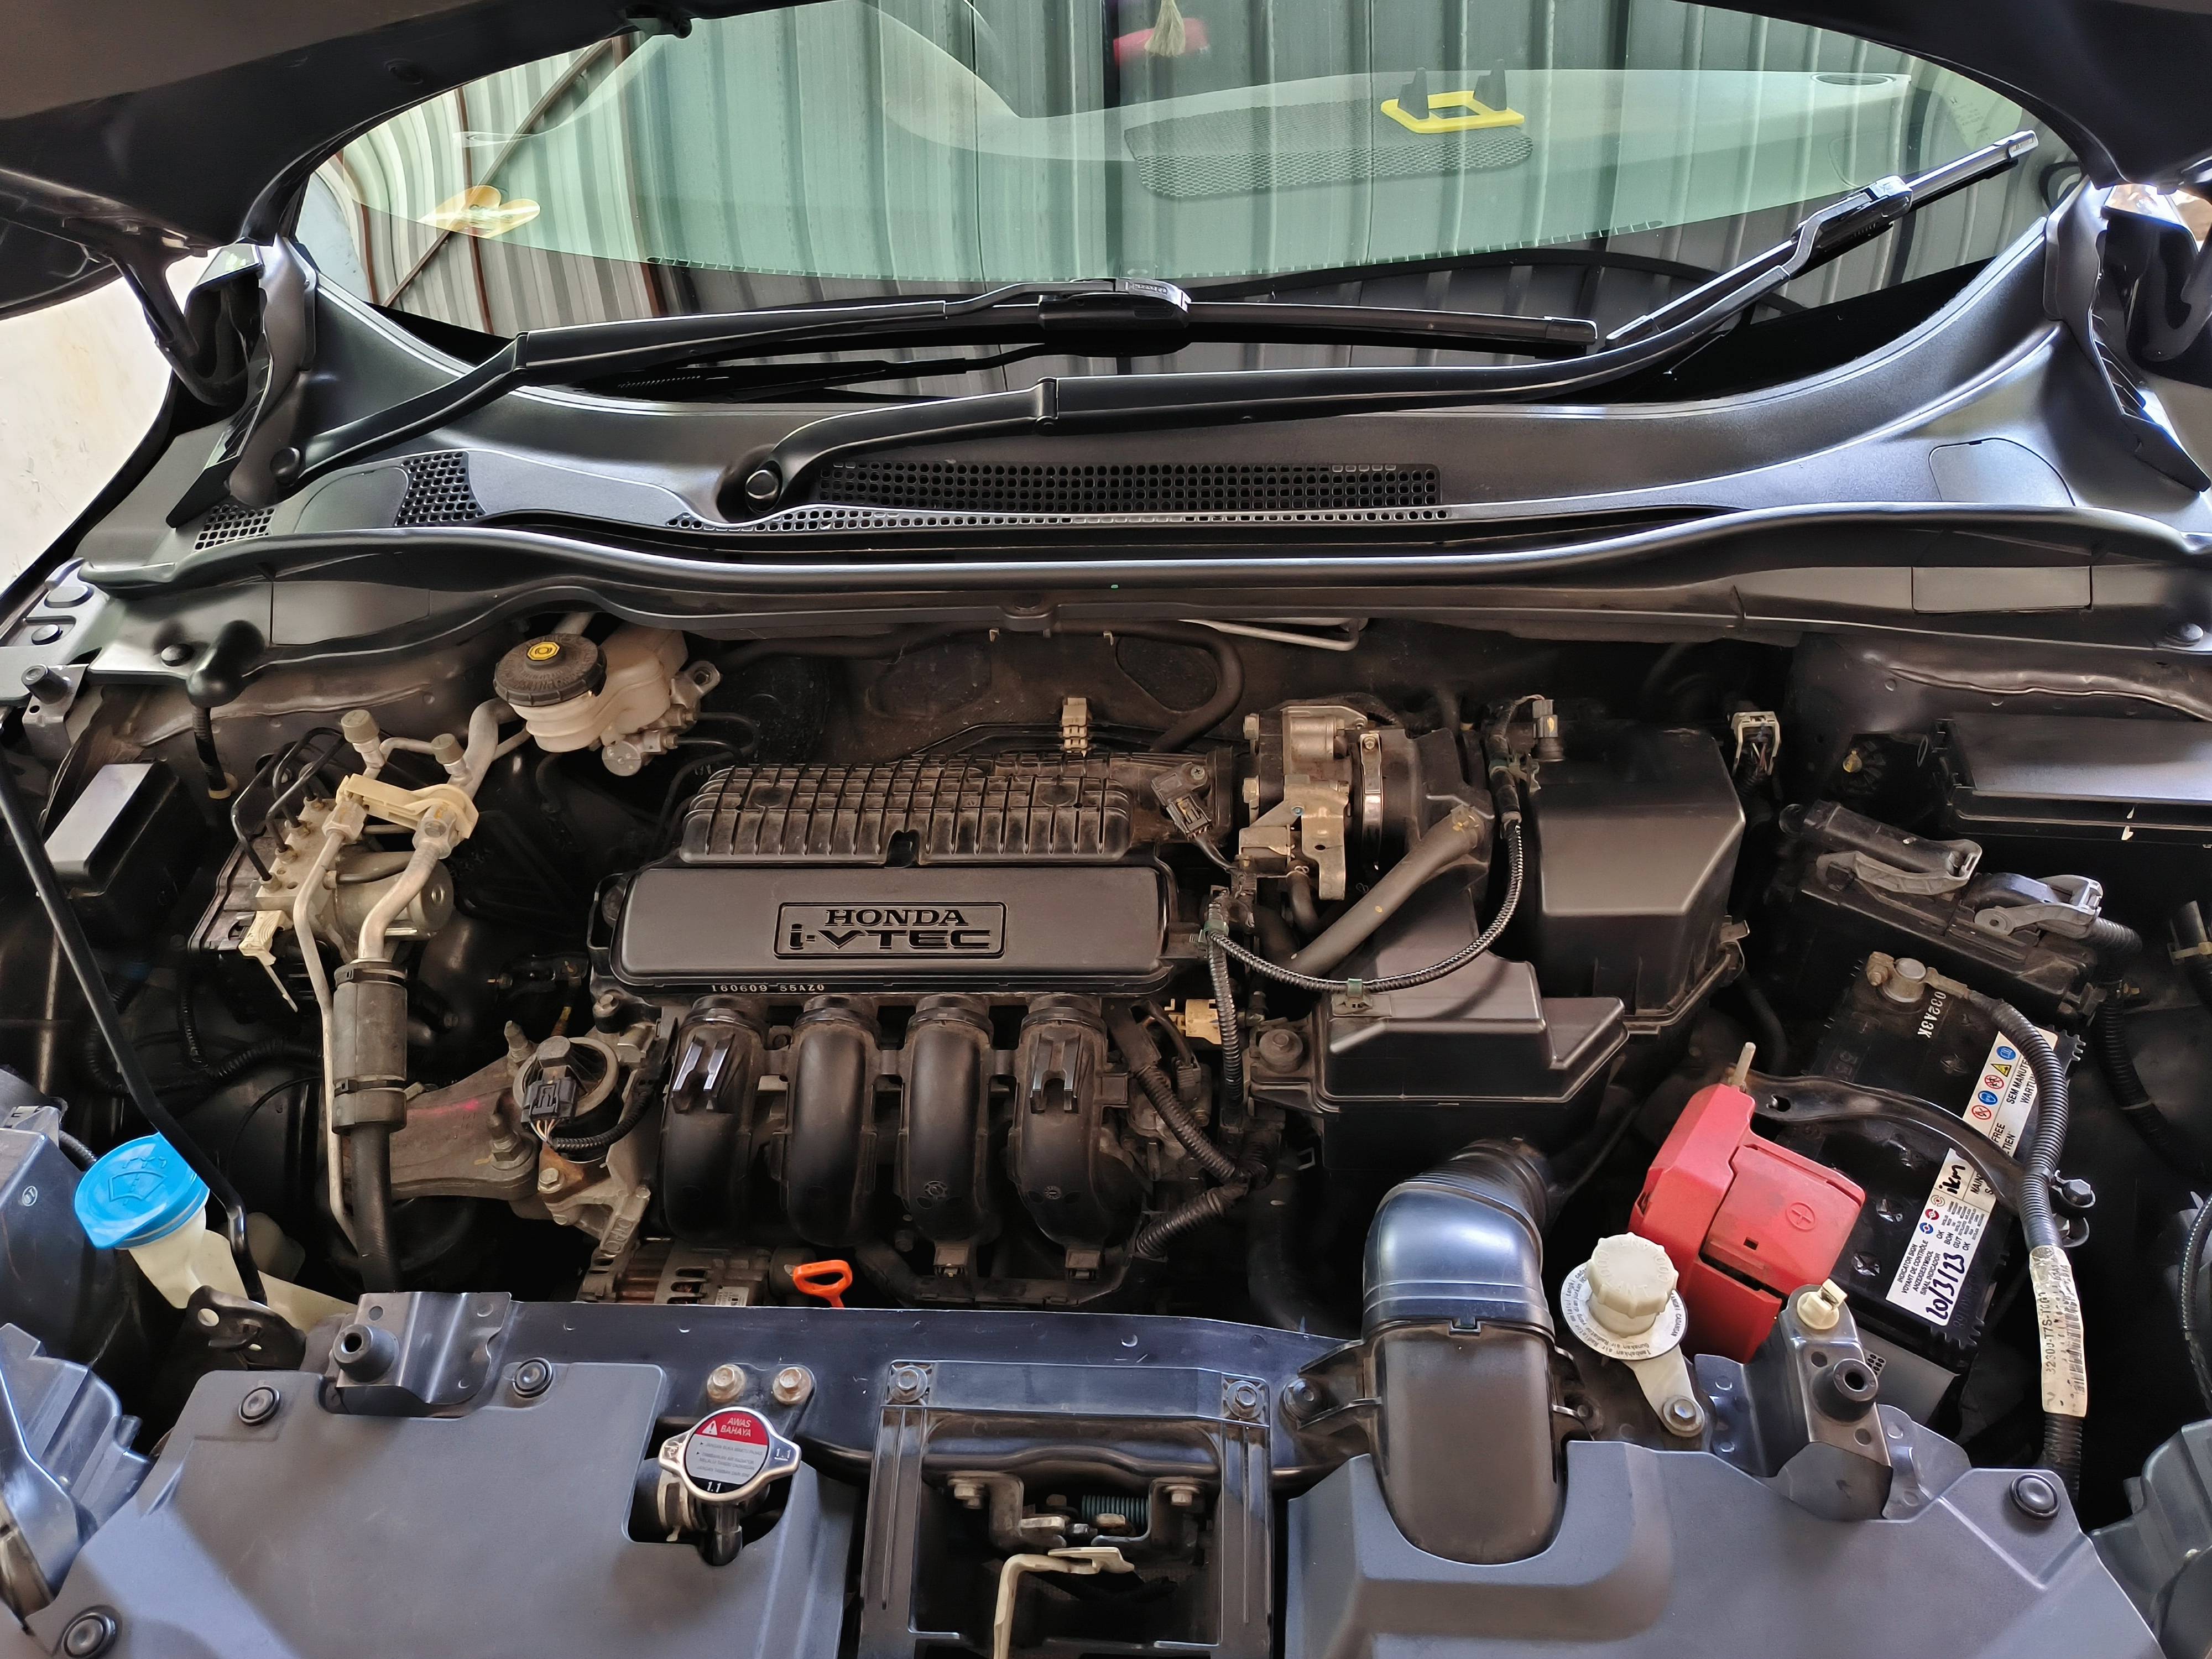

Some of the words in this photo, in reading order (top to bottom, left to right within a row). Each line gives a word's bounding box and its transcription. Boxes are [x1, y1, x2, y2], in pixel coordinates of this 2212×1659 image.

[825, 909, 969, 927] HONDA
[789, 924, 991, 950] i-VTEC
[1917, 992, 1947, 1039] 032A3K
[2006, 1087, 2019, 1104] SEM
[1991, 1123, 2005, 1142] FREE
[2001, 1133, 2016, 1155] TIEN
[1936, 1230, 1944, 1239] OK
[1943, 1232, 1954, 1245] BON
[1952, 1235, 1963, 1249] GUT
[1962, 1241, 1971, 1251] OK
[1897, 1255, 1912, 1283] INDICATOR
[1907, 1243, 1918, 1257] SIGN
[1926, 1253, 1941, 1280] INDICADOR
[1901, 1273, 1914, 1294] VOYANT
[1910, 1265, 1917, 1275] DE
[1575, 1324, 1599, 1348] Radiator
[720, 1426, 752, 1437] BAHAYA
[727, 1417, 752, 1428] AWAS
